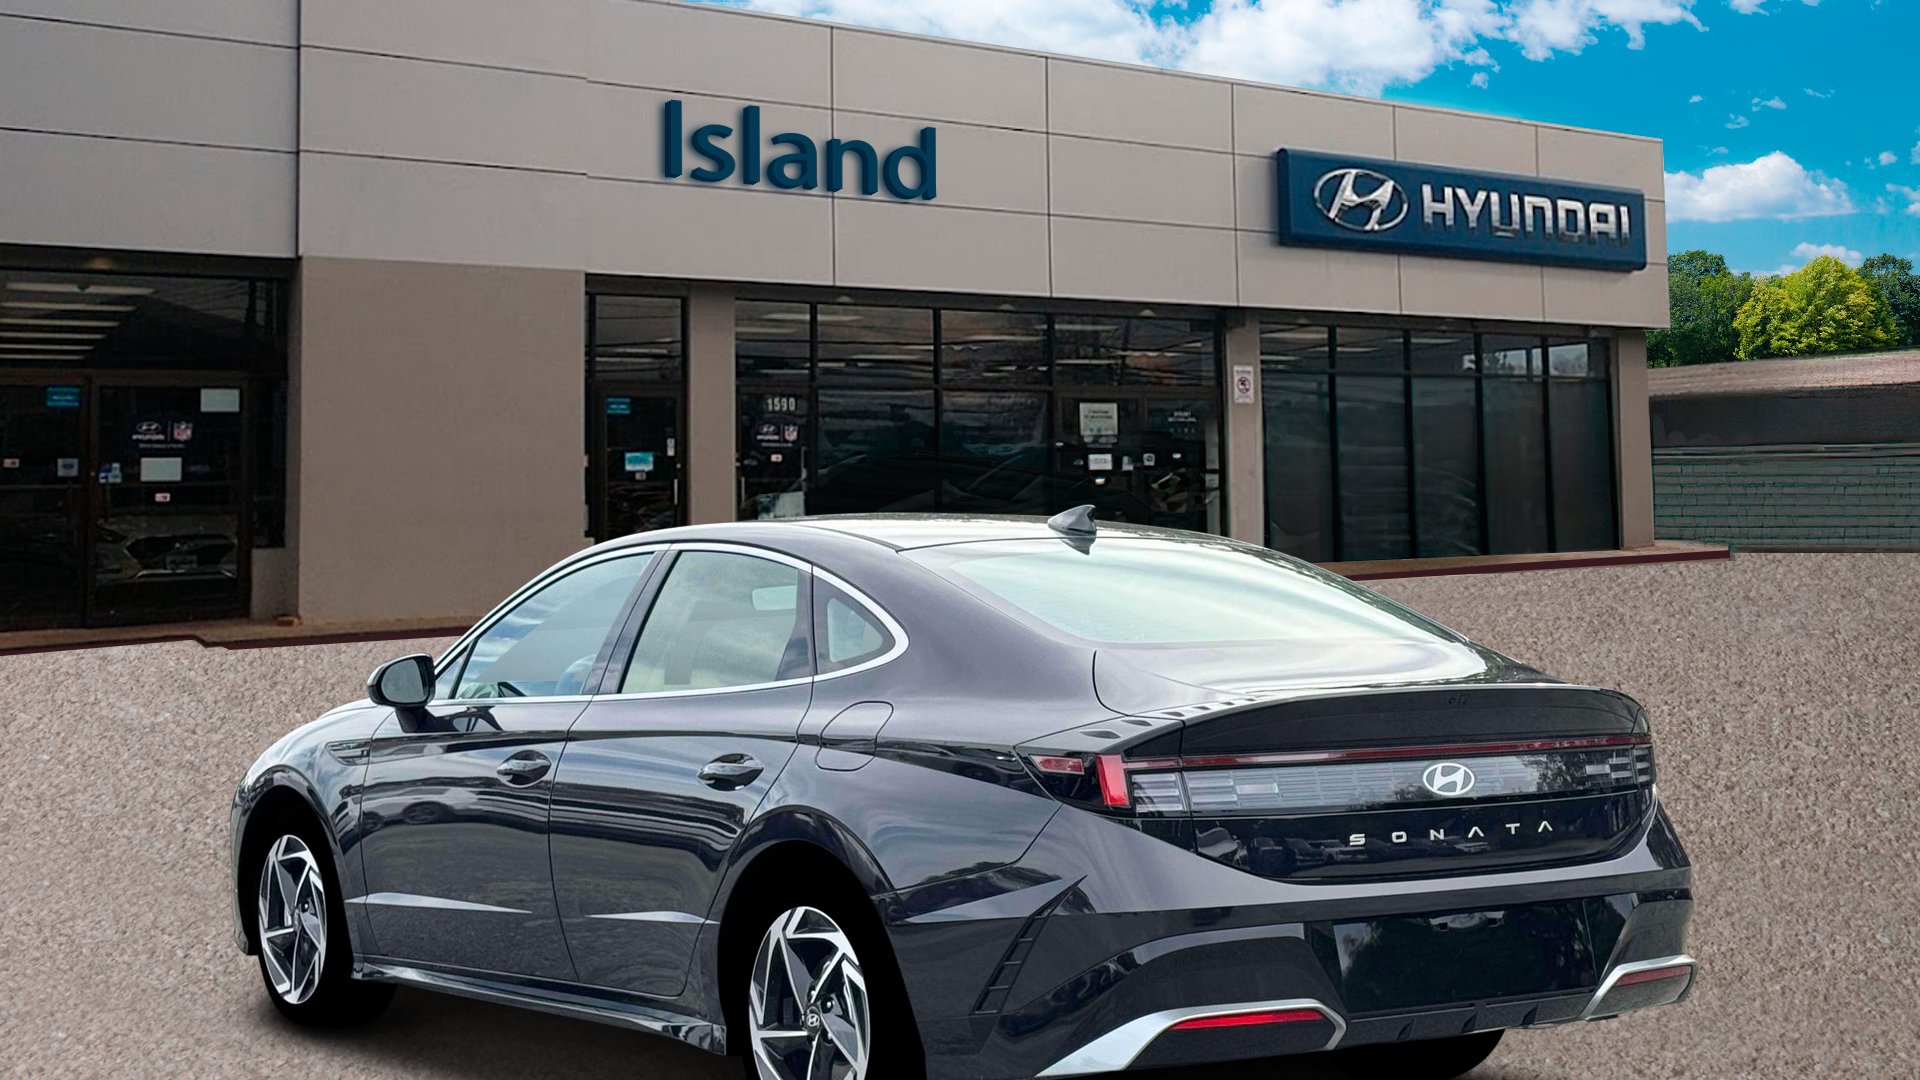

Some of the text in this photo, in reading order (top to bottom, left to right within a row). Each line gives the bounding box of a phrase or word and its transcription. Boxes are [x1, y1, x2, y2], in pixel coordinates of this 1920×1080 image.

[664, 99, 937, 200] Island
[1421, 184, 1630, 242] HYUNDAI
[766, 397, 797, 412] 1590
[1349, 820, 1554, 847] SONATA
